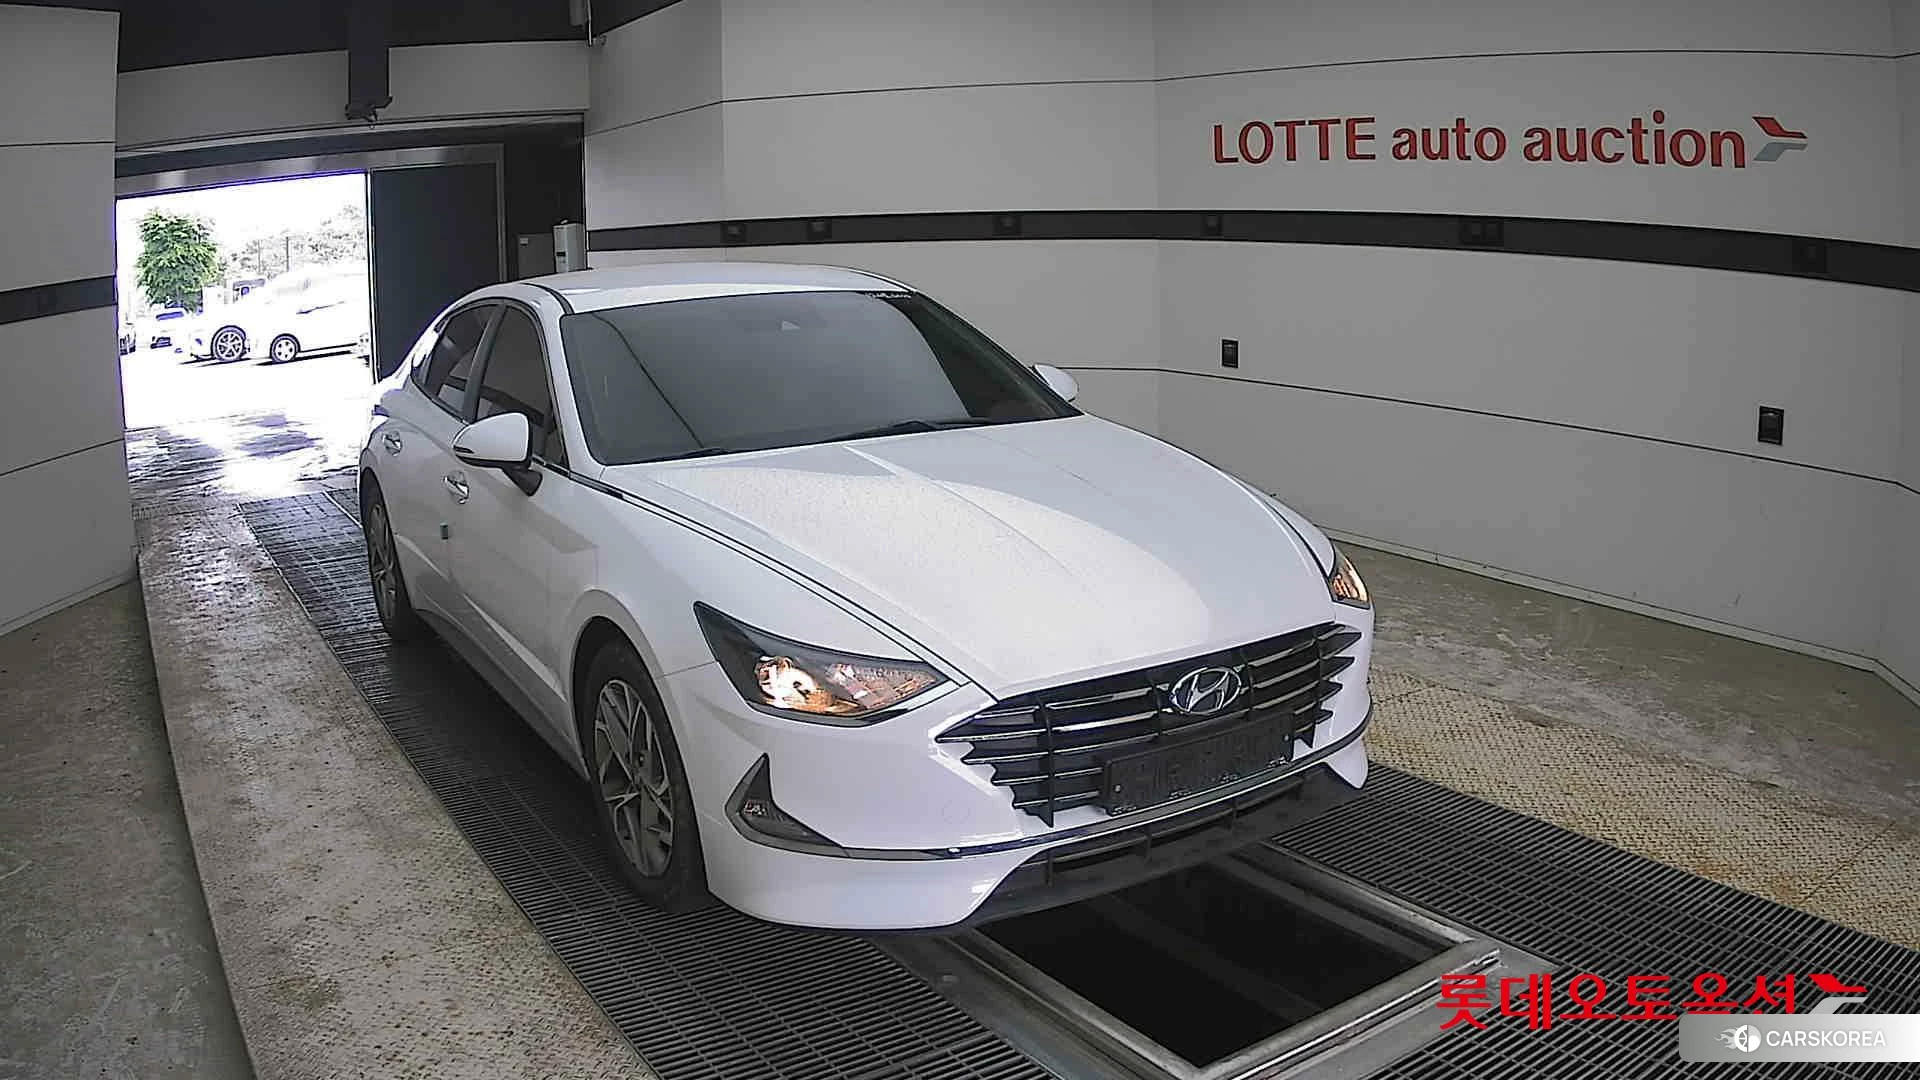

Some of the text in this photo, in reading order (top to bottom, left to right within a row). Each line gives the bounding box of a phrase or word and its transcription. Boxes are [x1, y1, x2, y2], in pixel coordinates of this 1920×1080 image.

[1212, 109, 1746, 169] LOTTE auto auction
